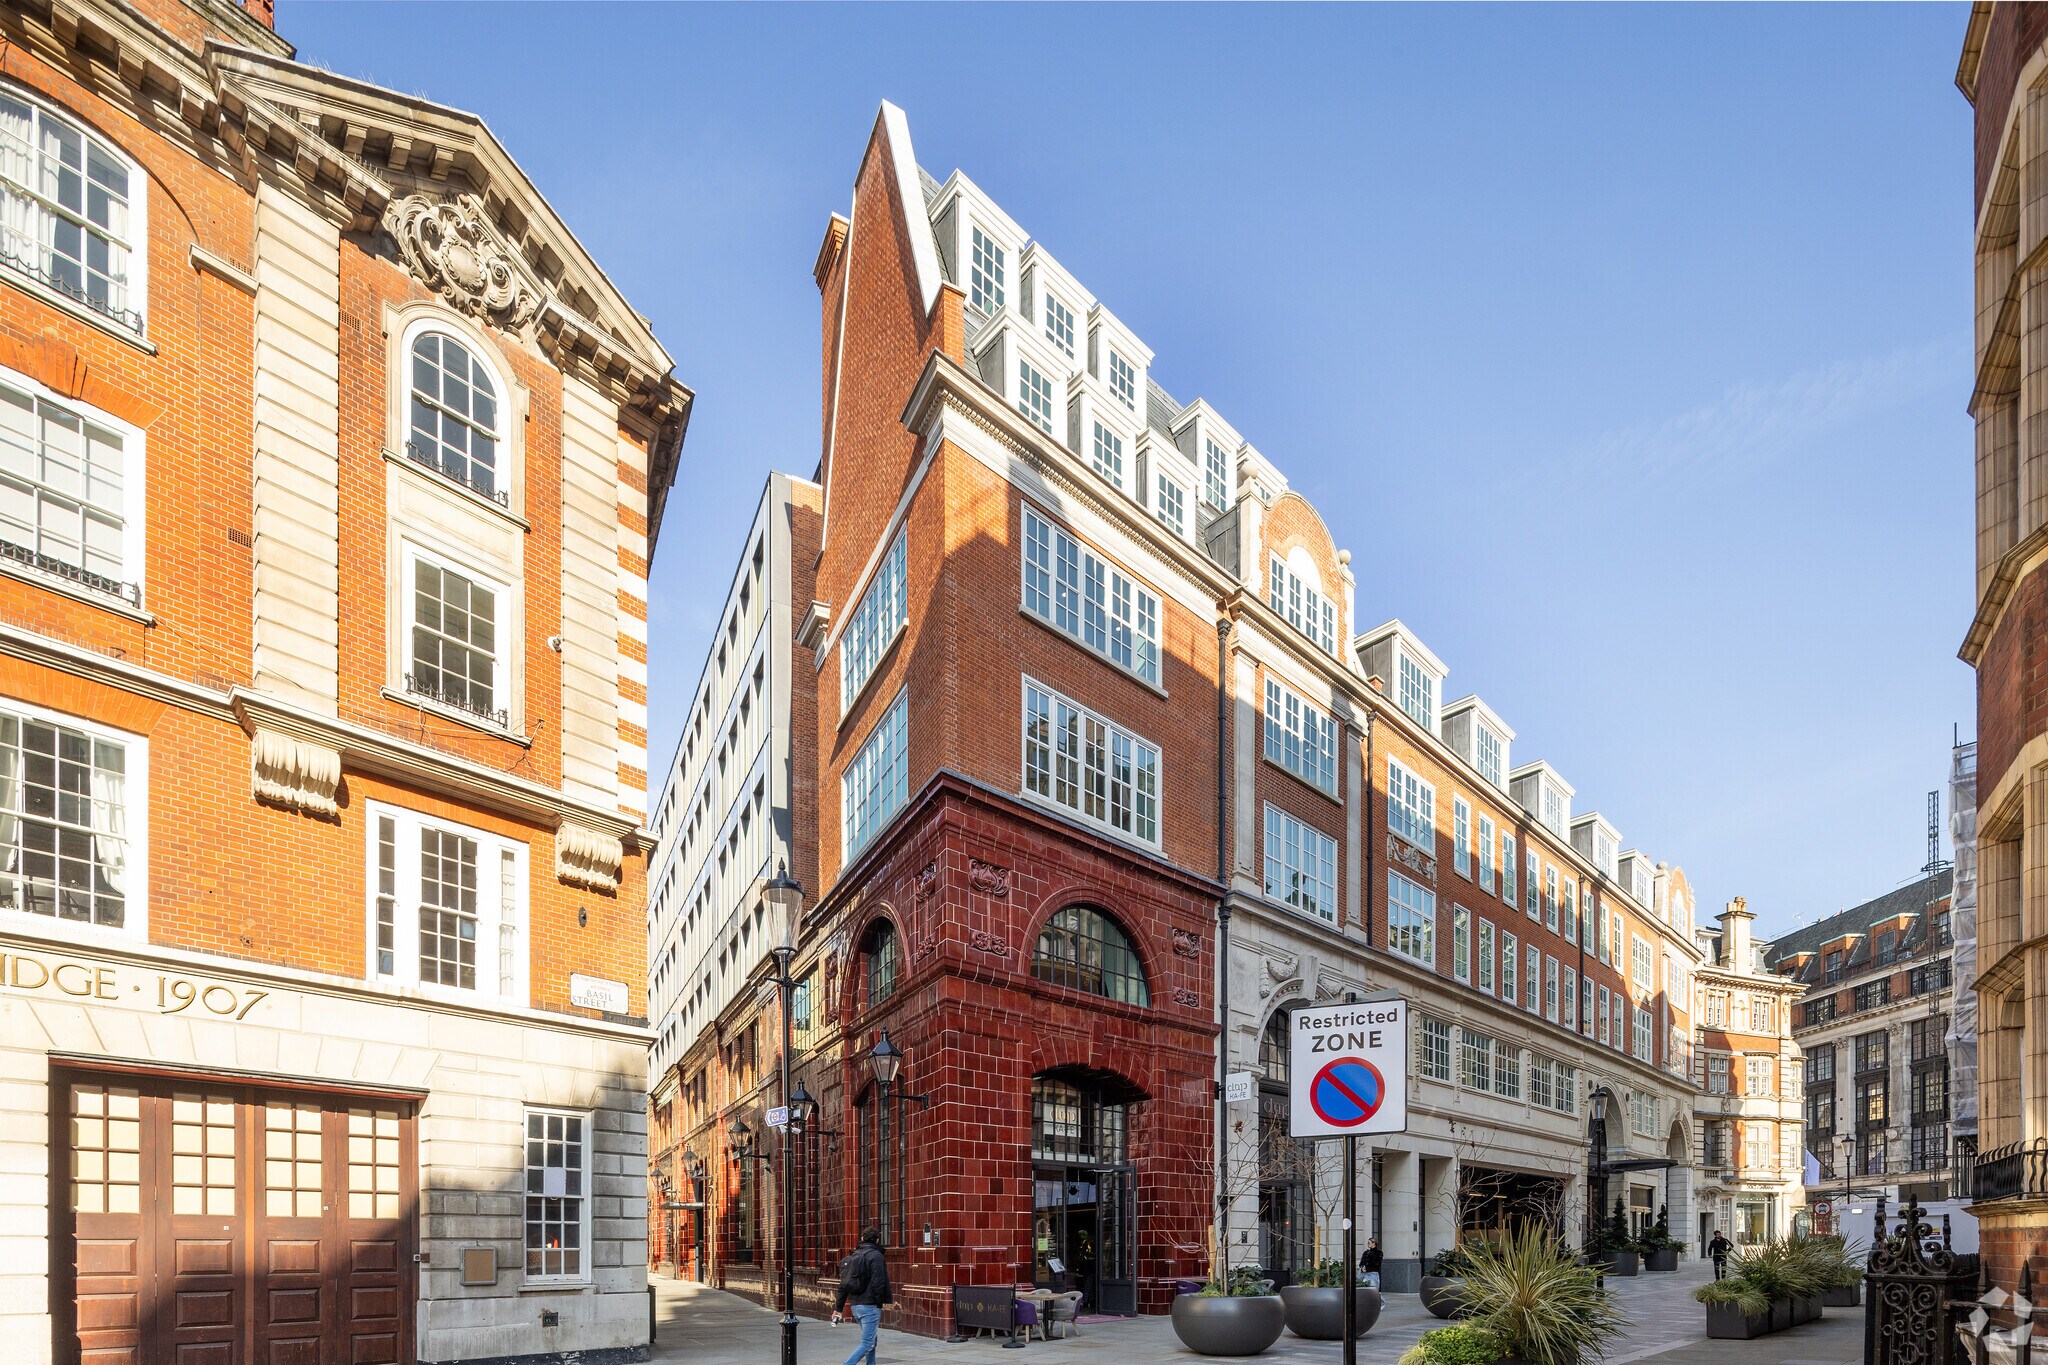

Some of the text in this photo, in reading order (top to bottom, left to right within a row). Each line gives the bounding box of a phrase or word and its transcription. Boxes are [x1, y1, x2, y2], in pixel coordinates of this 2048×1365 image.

[157, 976, 269, 1020] 1907
[572, 995, 607, 1008] STREET
[586, 990, 613, 1001] BASIL
[1299, 1008, 1398, 1030] Restricted
[1311, 1030, 1383, 1053] ZONE
